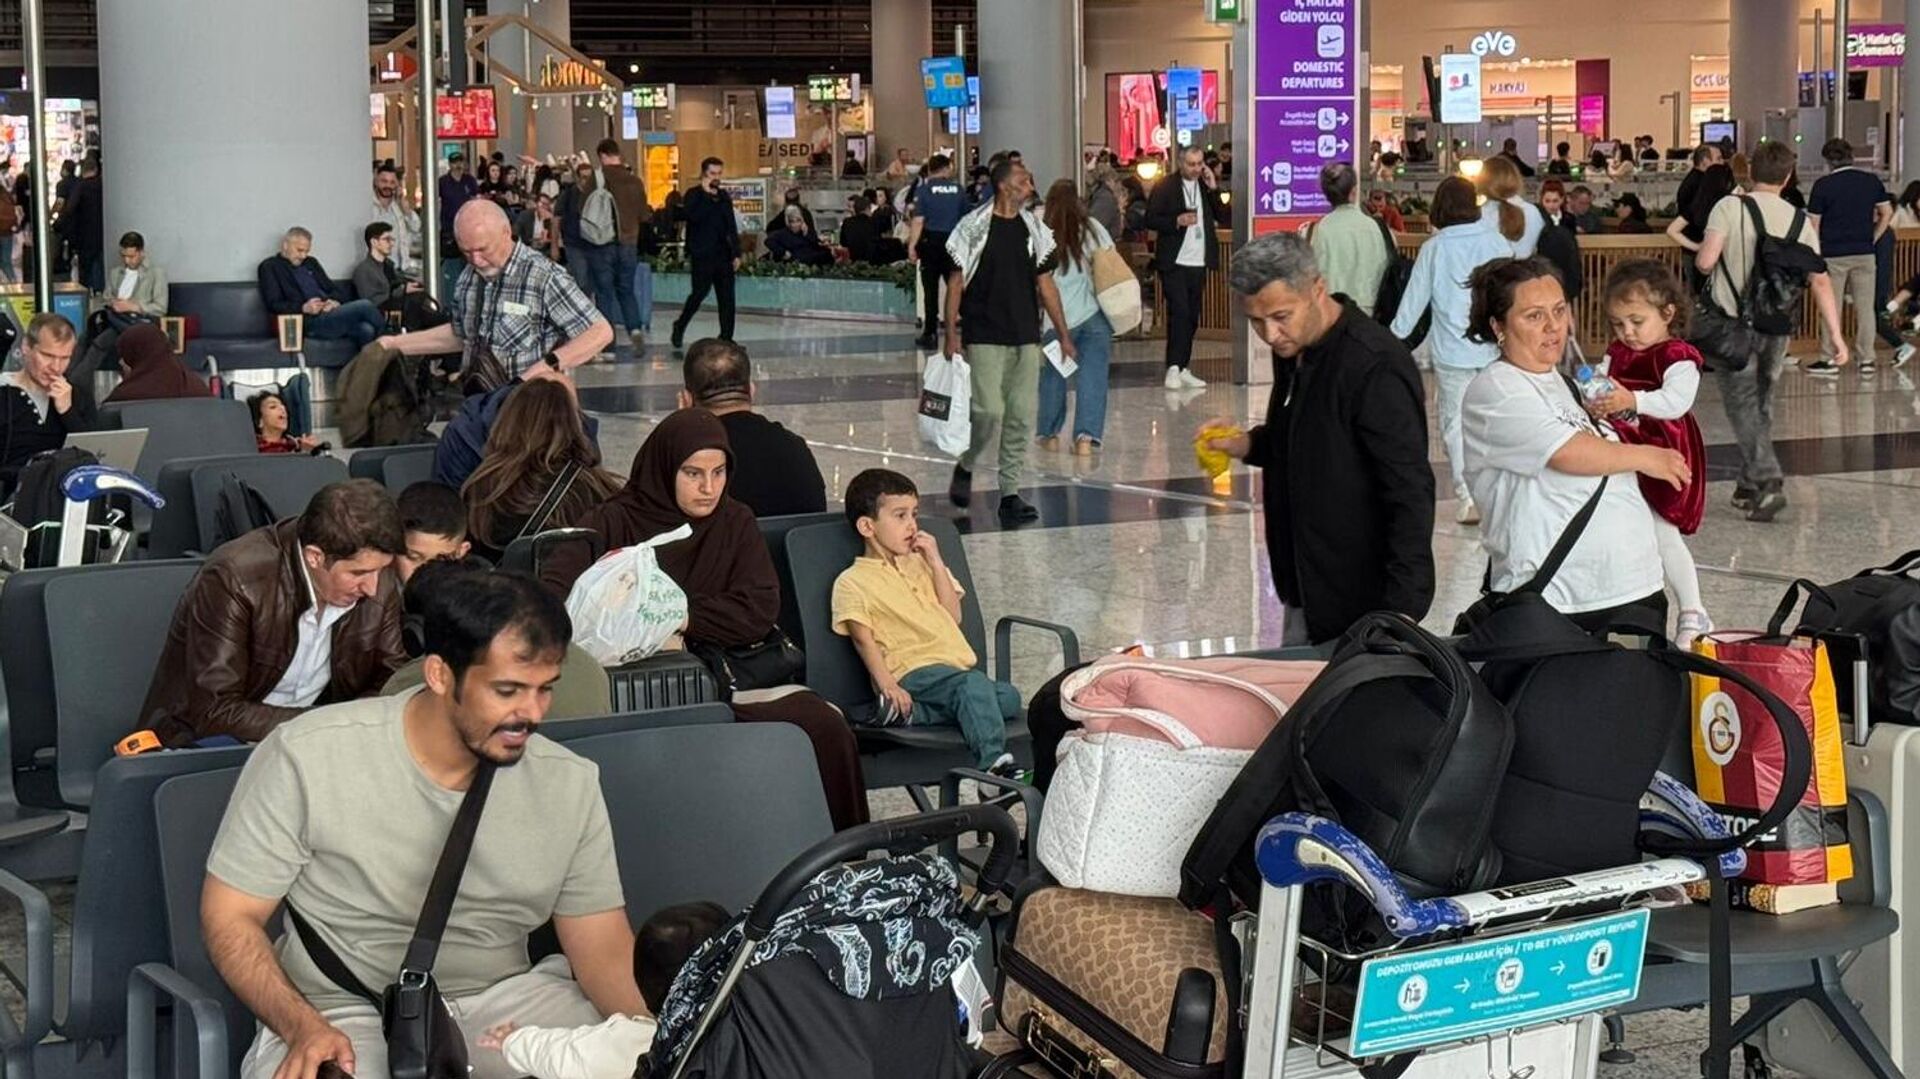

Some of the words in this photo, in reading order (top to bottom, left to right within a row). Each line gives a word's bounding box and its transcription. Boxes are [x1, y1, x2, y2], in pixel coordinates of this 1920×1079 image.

[1280, 10, 1311, 22] GİDEN
[1312, 11, 1344, 22] YOLCU
[1293, 61, 1344, 73] DOMESTIC
[1281, 77, 1344, 88] DEPARTURES
